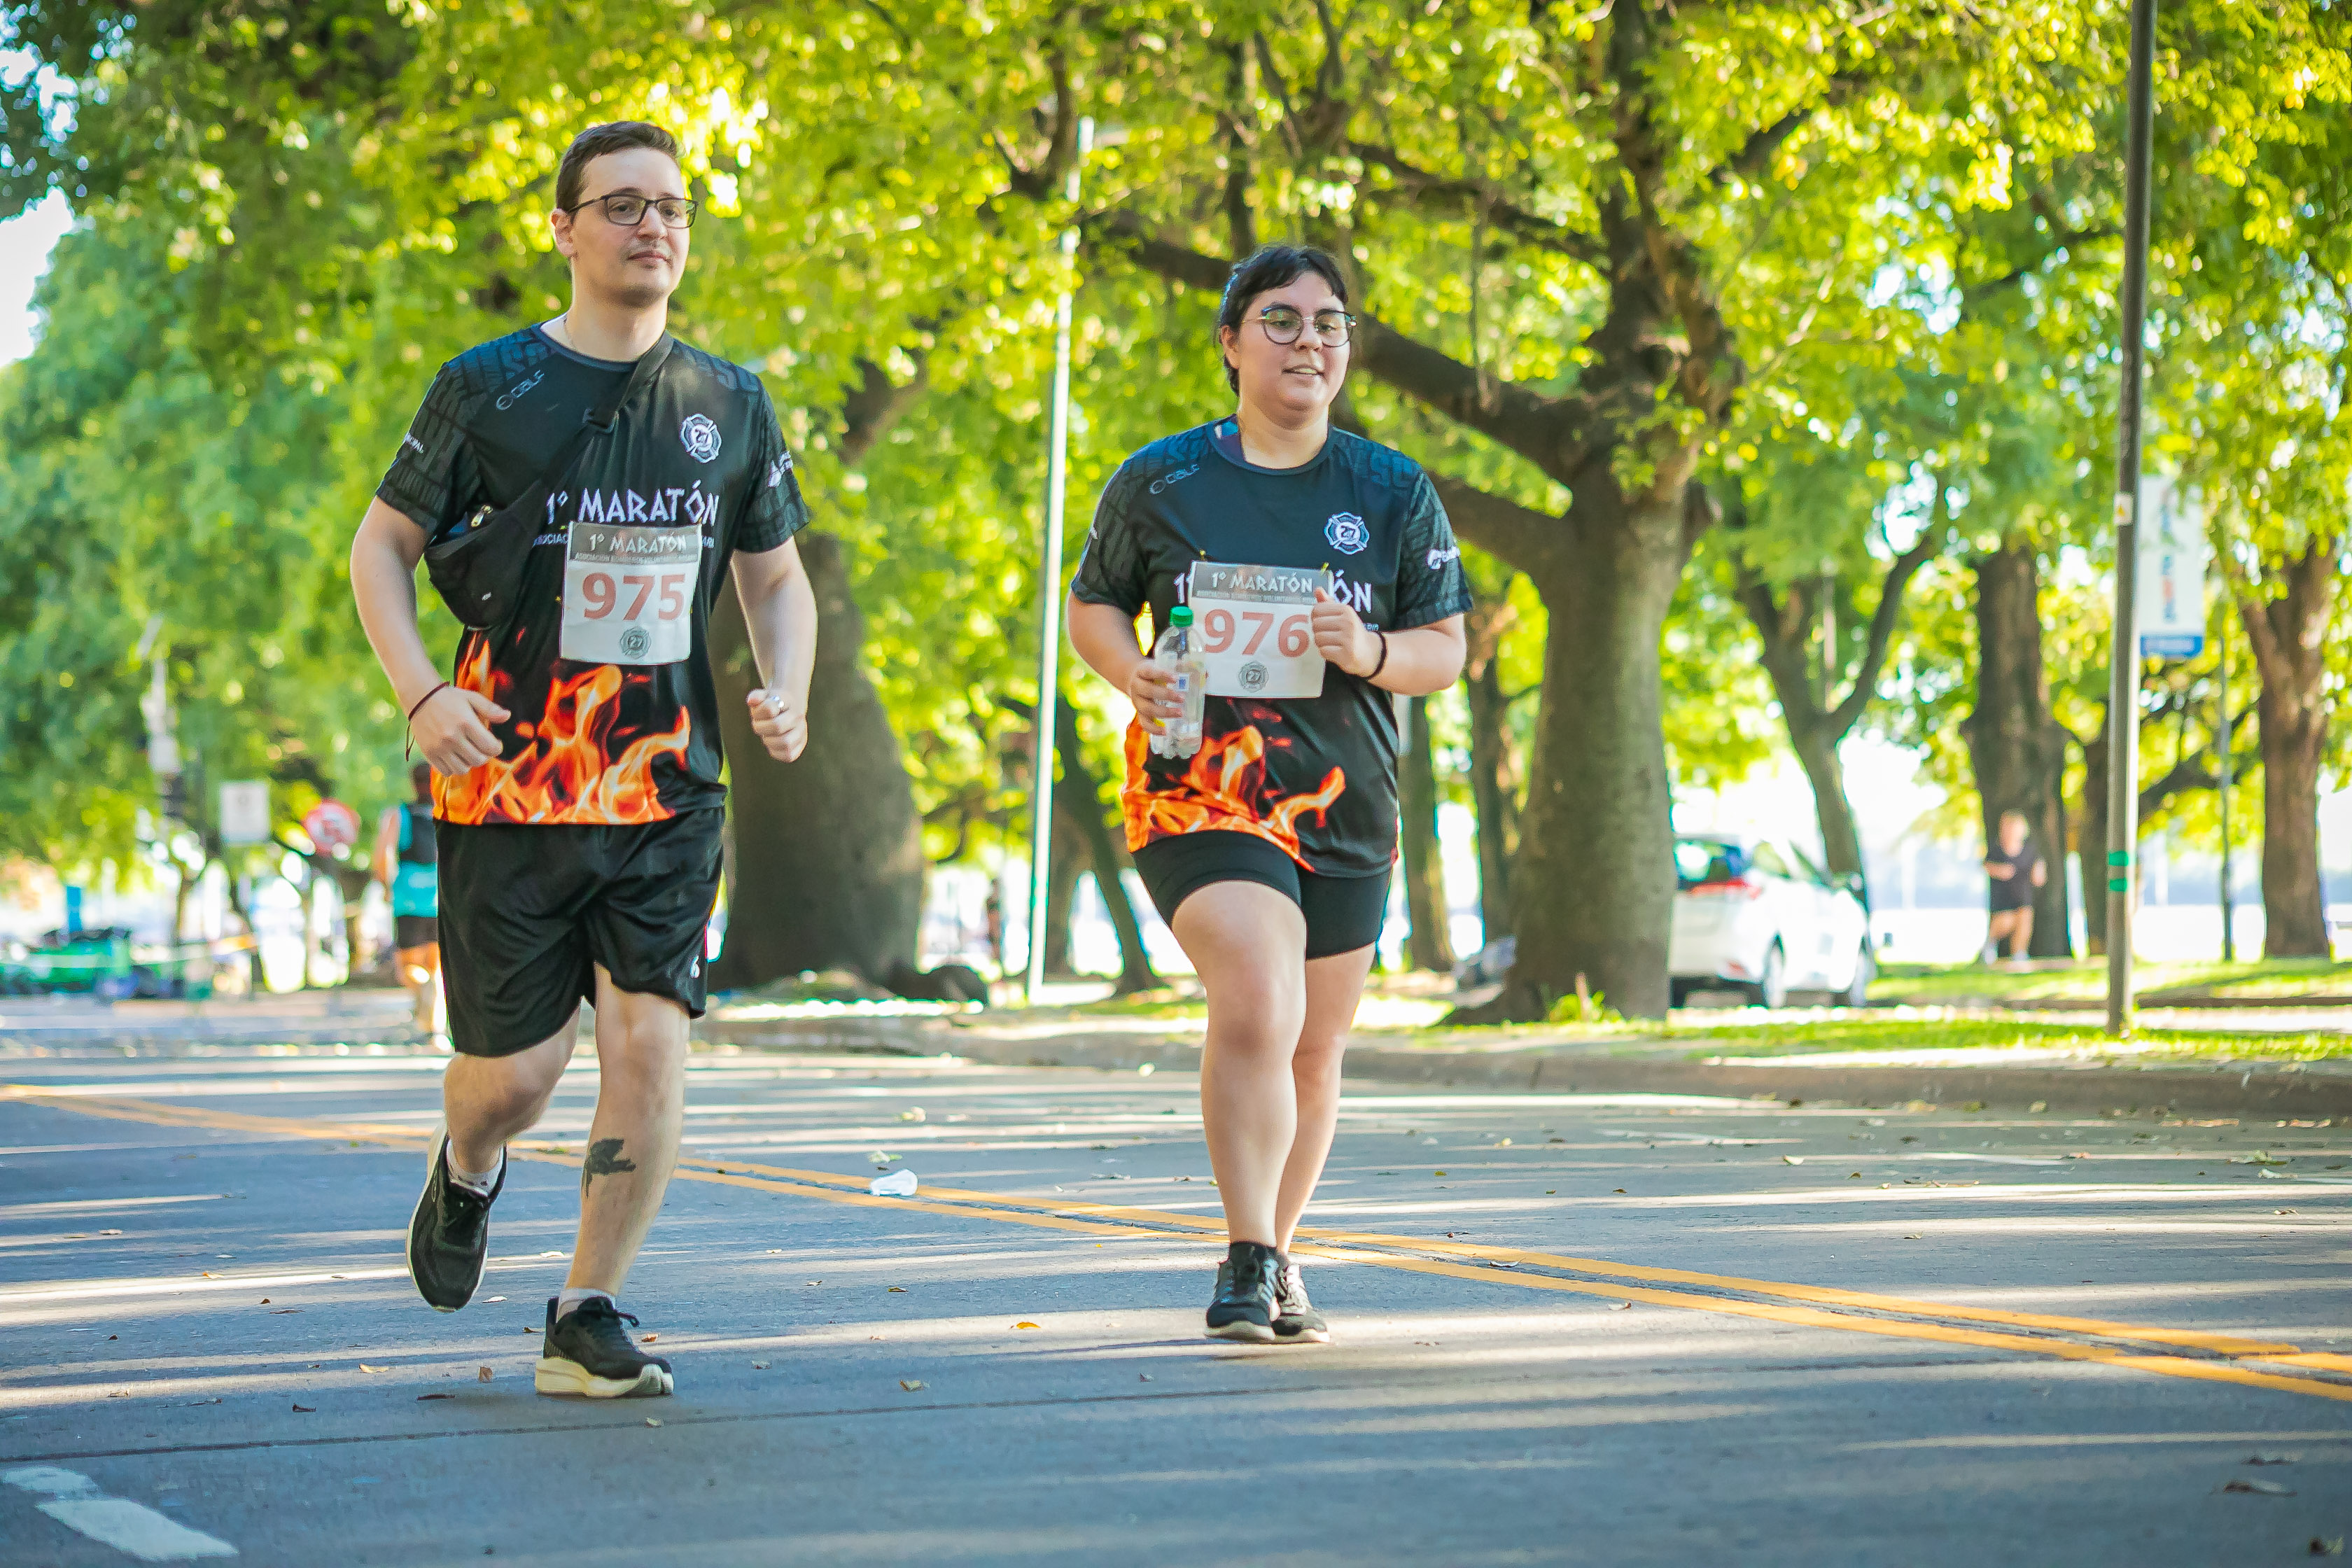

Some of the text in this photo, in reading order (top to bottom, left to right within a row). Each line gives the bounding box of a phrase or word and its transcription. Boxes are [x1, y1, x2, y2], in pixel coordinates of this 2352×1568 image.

[578, 479, 720, 526] MARATÓN
[609, 532, 687, 554] MARATÓN
[582, 572, 686, 622] 975
[1229, 572, 1313, 594] MARATÓN
[1204, 608, 1310, 658] 976
